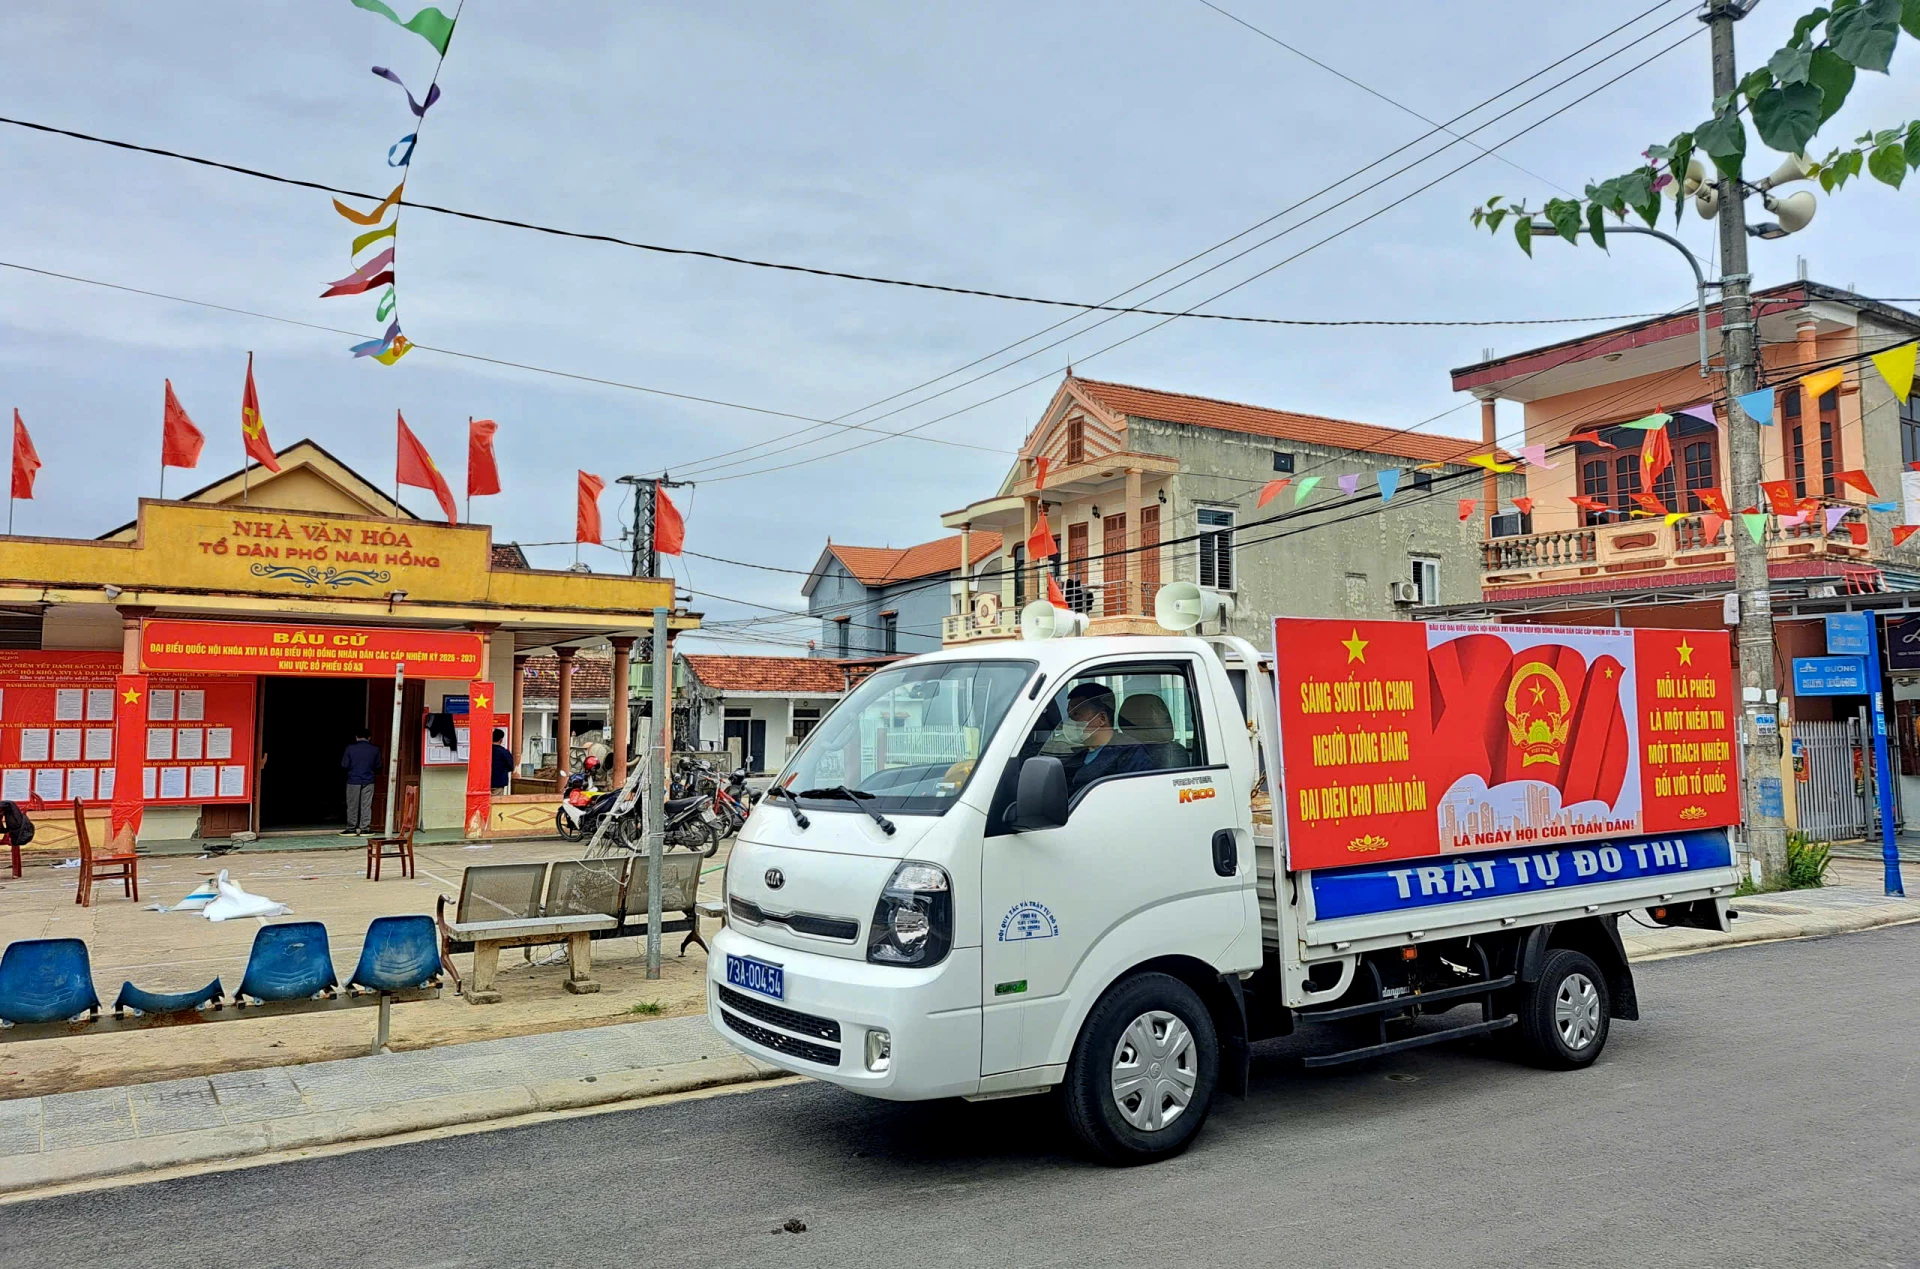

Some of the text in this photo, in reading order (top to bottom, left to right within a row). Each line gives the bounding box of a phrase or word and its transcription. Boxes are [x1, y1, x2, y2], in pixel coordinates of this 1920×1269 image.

[233, 519, 412, 548] NHÀ VĂN HÓA
[199, 537, 440, 568] TỔ DÂN PHỐ NAM HỒNG
[150, 643, 164, 654] ĐẠI
[166, 641, 184, 654] BIỂU
[186, 642, 206, 655] QUỐC
[208, 645, 220, 656] HỘI
[222, 645, 243, 655] KHÓA
[245, 646, 257, 656] XVI
[259, 646, 268, 656] VÀ
[270, 648, 282, 658] ĐẠI
[284, 645, 300, 657] BIỂU
[303, 647, 314, 659] HỘI
[316, 647, 336, 658] ĐỒNG
[338, 648, 358, 659] NHÂN
[359, 649, 374, 660] DÂN
[376, 649, 388, 660] CÁC
[390, 649, 404, 660] CẤP
[406, 650, 428, 662] NHIỆM
[430, 652, 438, 662] KỲ
[440, 654, 455, 662] 2026
[461, 654, 476, 662] 2031
[273, 630, 368, 646] BẦU CỬ
[279, 659, 363, 672] KHU VỰC BỎ PHIẾU SỐ 43
[1301, 670, 1414, 718] SÁNG SUỐT LỰA CHỌN
[1656, 671, 1716, 698] MỖI LÁ PHIẾU
[1650, 707, 1662, 731] LÀ
[1664, 707, 1683, 735] MỘT
[1710, 710, 1725, 730] TIN
[1313, 724, 1409, 767] NGƯỜI XỨNG ĐÁNG
[1648, 738, 1730, 769] MỘT TRÁCH NHIỆM
[1172, 776, 1213, 787] FRONTIER
[1179, 787, 1216, 804] K200
[1655, 766, 1727, 797] ĐỐI VỚI TỔ QUỐC
[1300, 774, 1427, 828] ĐẠI DIỆN CHO NHÂN DÂN
[1453, 818, 1634, 847] LÀ NGÀY HỘI CỦA TOÀN DÂN!
[767, 871, 781, 886] KIA
[1387, 839, 1689, 899] TRẬT TỰ ĐÔ THỊ
[728, 957, 781, 996] 73A-004.54
